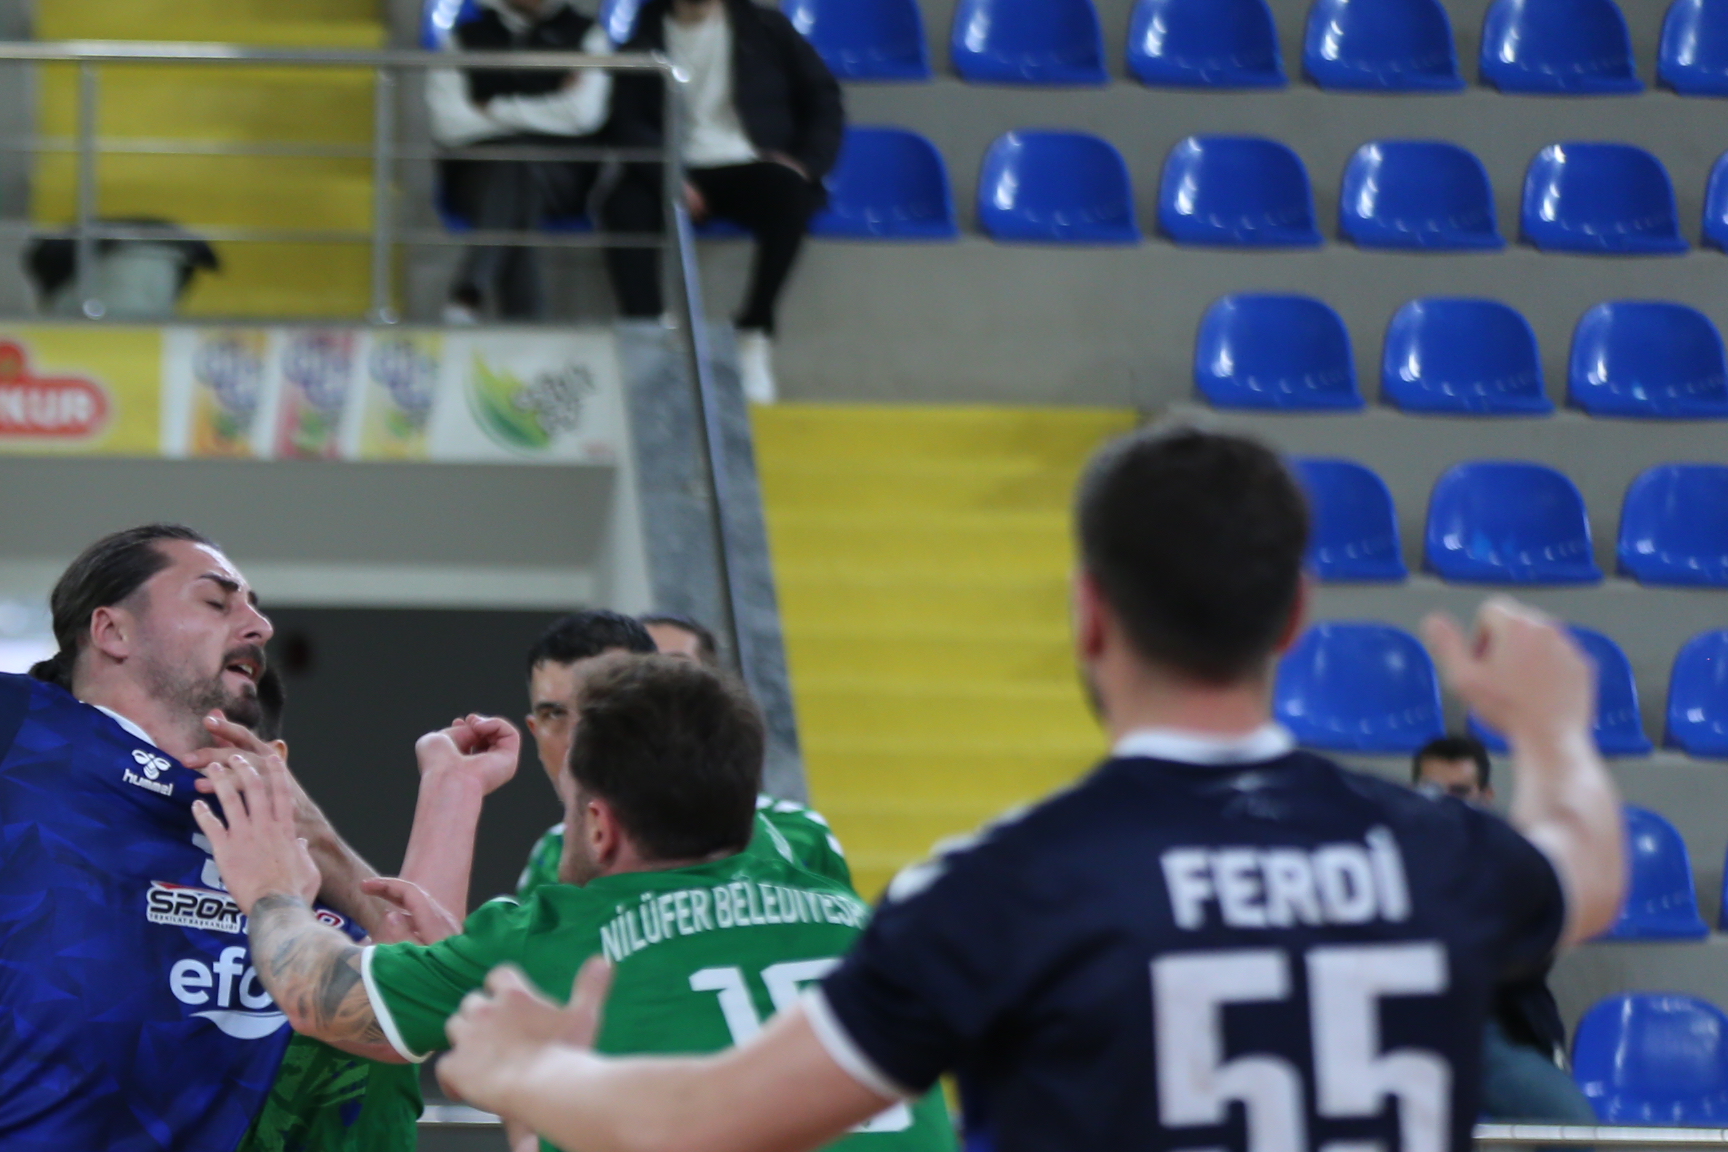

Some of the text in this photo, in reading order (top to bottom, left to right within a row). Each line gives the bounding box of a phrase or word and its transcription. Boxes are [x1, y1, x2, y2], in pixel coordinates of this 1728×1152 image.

[122, 768, 174, 797] hummel
[150, 889, 243, 924] SPOR
[1160, 826, 1411, 930] FERDİ
[600, 889, 714, 967] NİLÜFER
[169, 945, 276, 1010] efo
